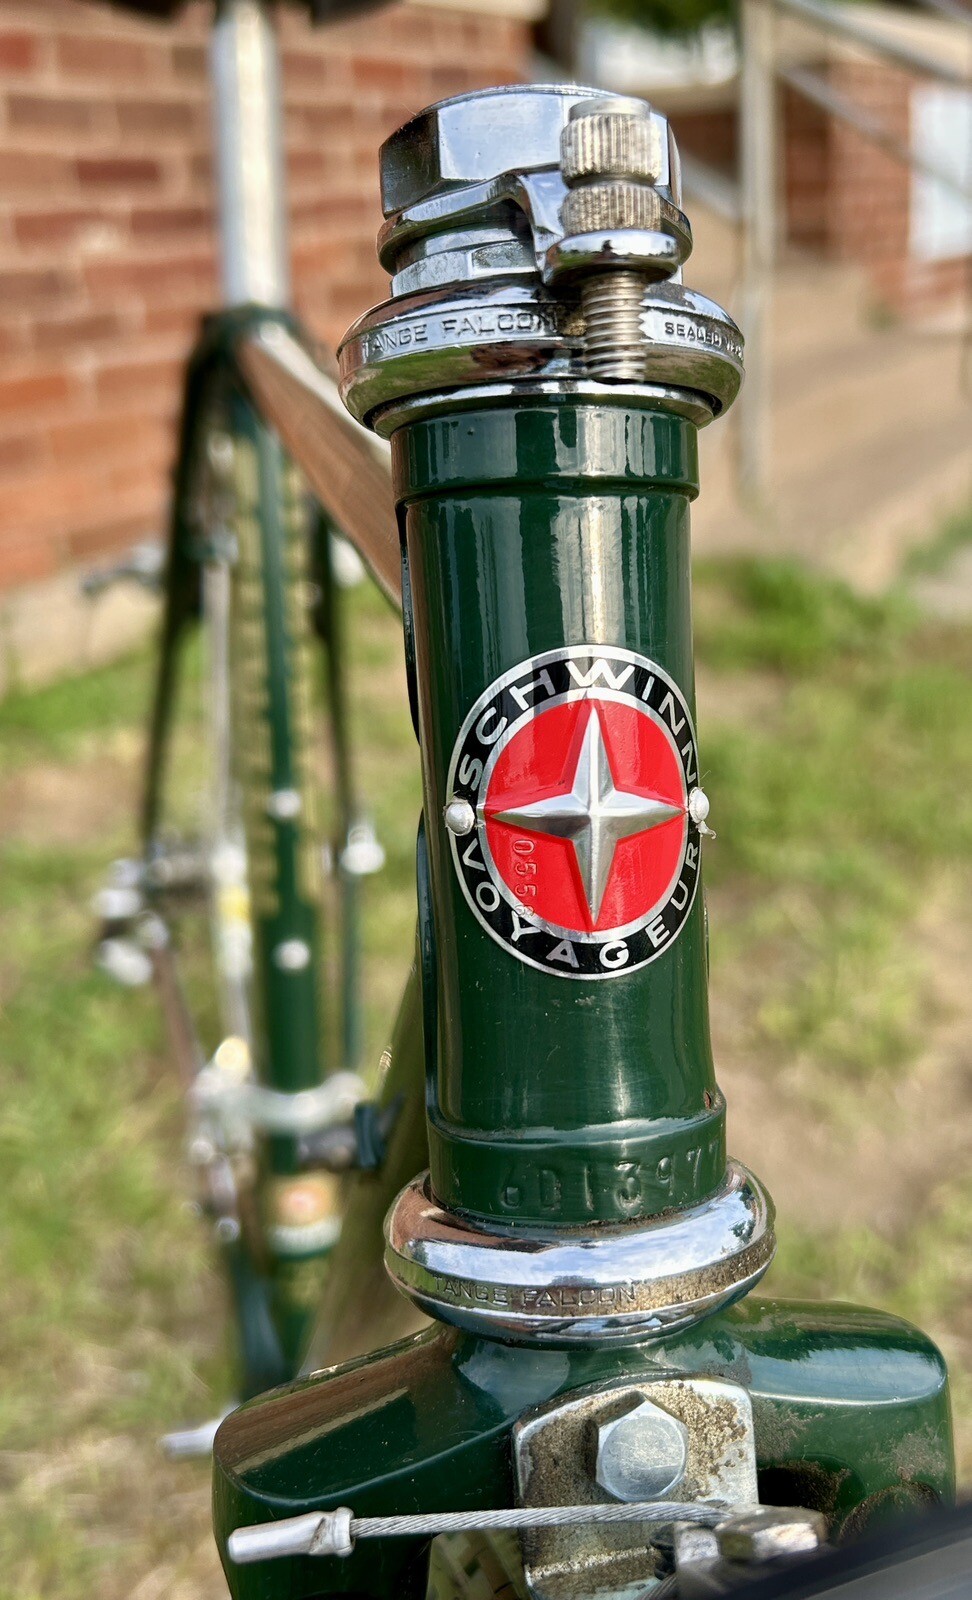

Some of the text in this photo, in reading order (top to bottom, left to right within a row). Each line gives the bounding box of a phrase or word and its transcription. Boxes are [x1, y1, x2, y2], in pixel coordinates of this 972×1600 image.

[362, 312, 559, 361] TANGE FALCON
[459, 658, 697, 790] SCHWINN
[462, 838, 699, 968] VOYAGEUR
[433, 1276, 636, 1308] TANGE FALCON
